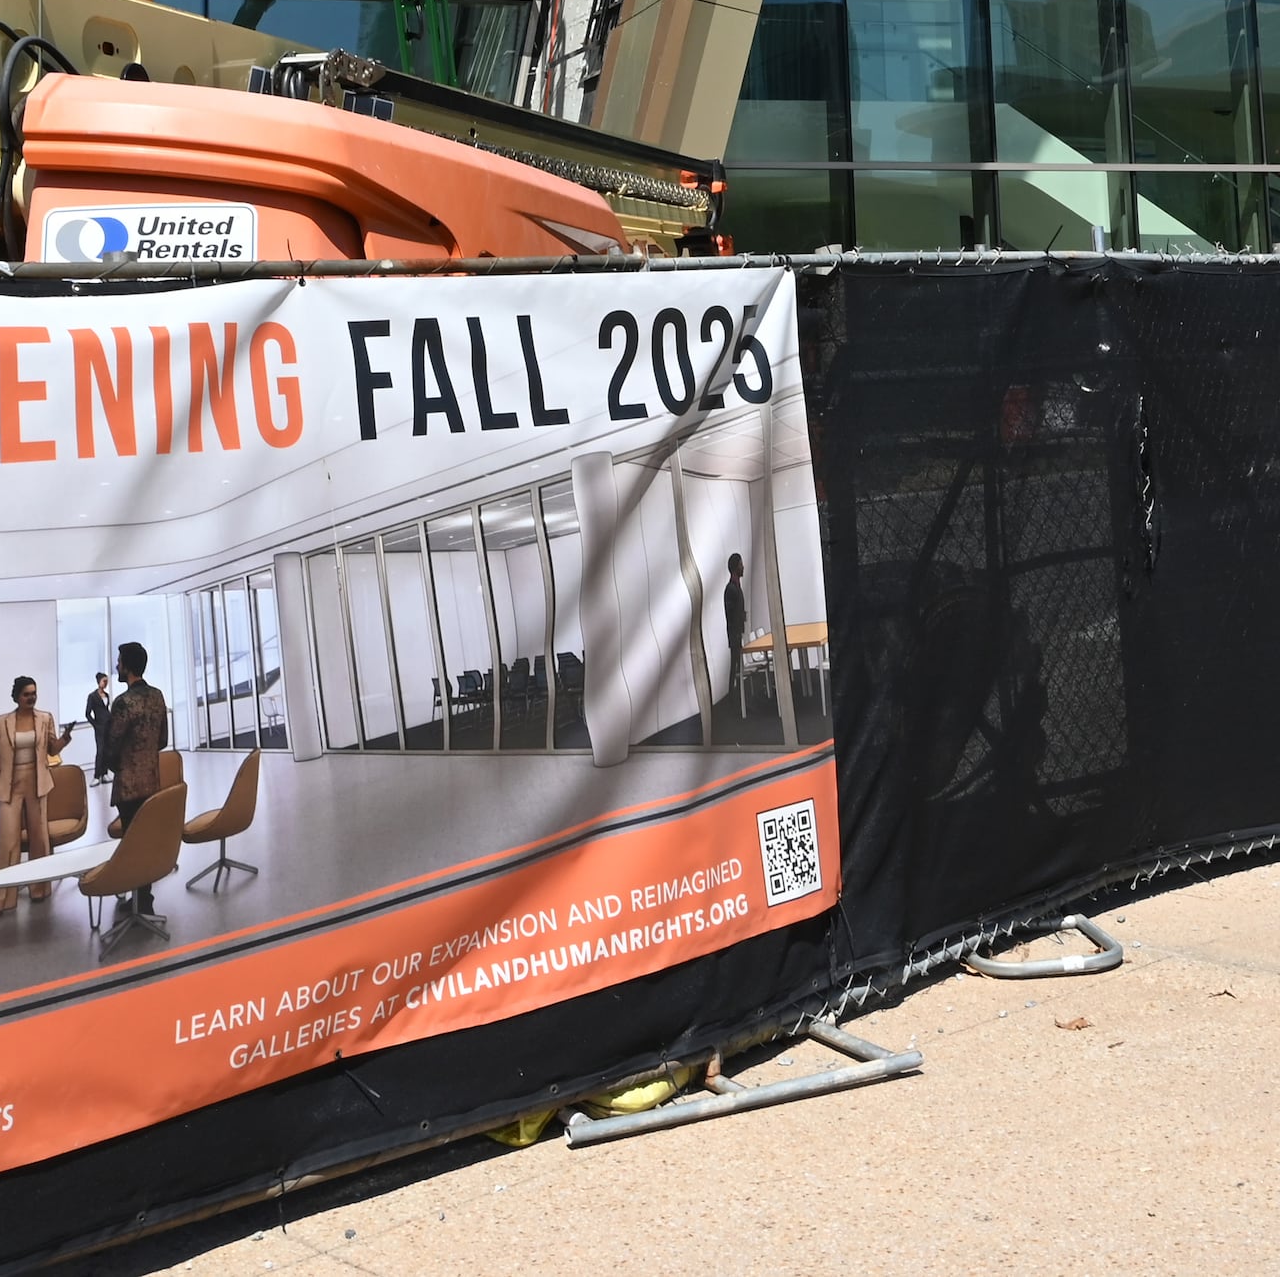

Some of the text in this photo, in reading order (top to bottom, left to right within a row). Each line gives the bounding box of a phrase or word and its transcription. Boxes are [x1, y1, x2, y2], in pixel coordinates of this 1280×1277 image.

[136, 238, 243, 259] Rentals
[137, 216, 234, 236] United
[347, 314, 570, 441] FALL
[598, 305, 773, 422] 2025
[175, 858, 743, 1044] LEARN ABOUT OUR EXPANSION AND REIMAGINED
[229, 894, 748, 1069] GALLERIES AT CIVILANDHUMANRIGHTS.ORG
